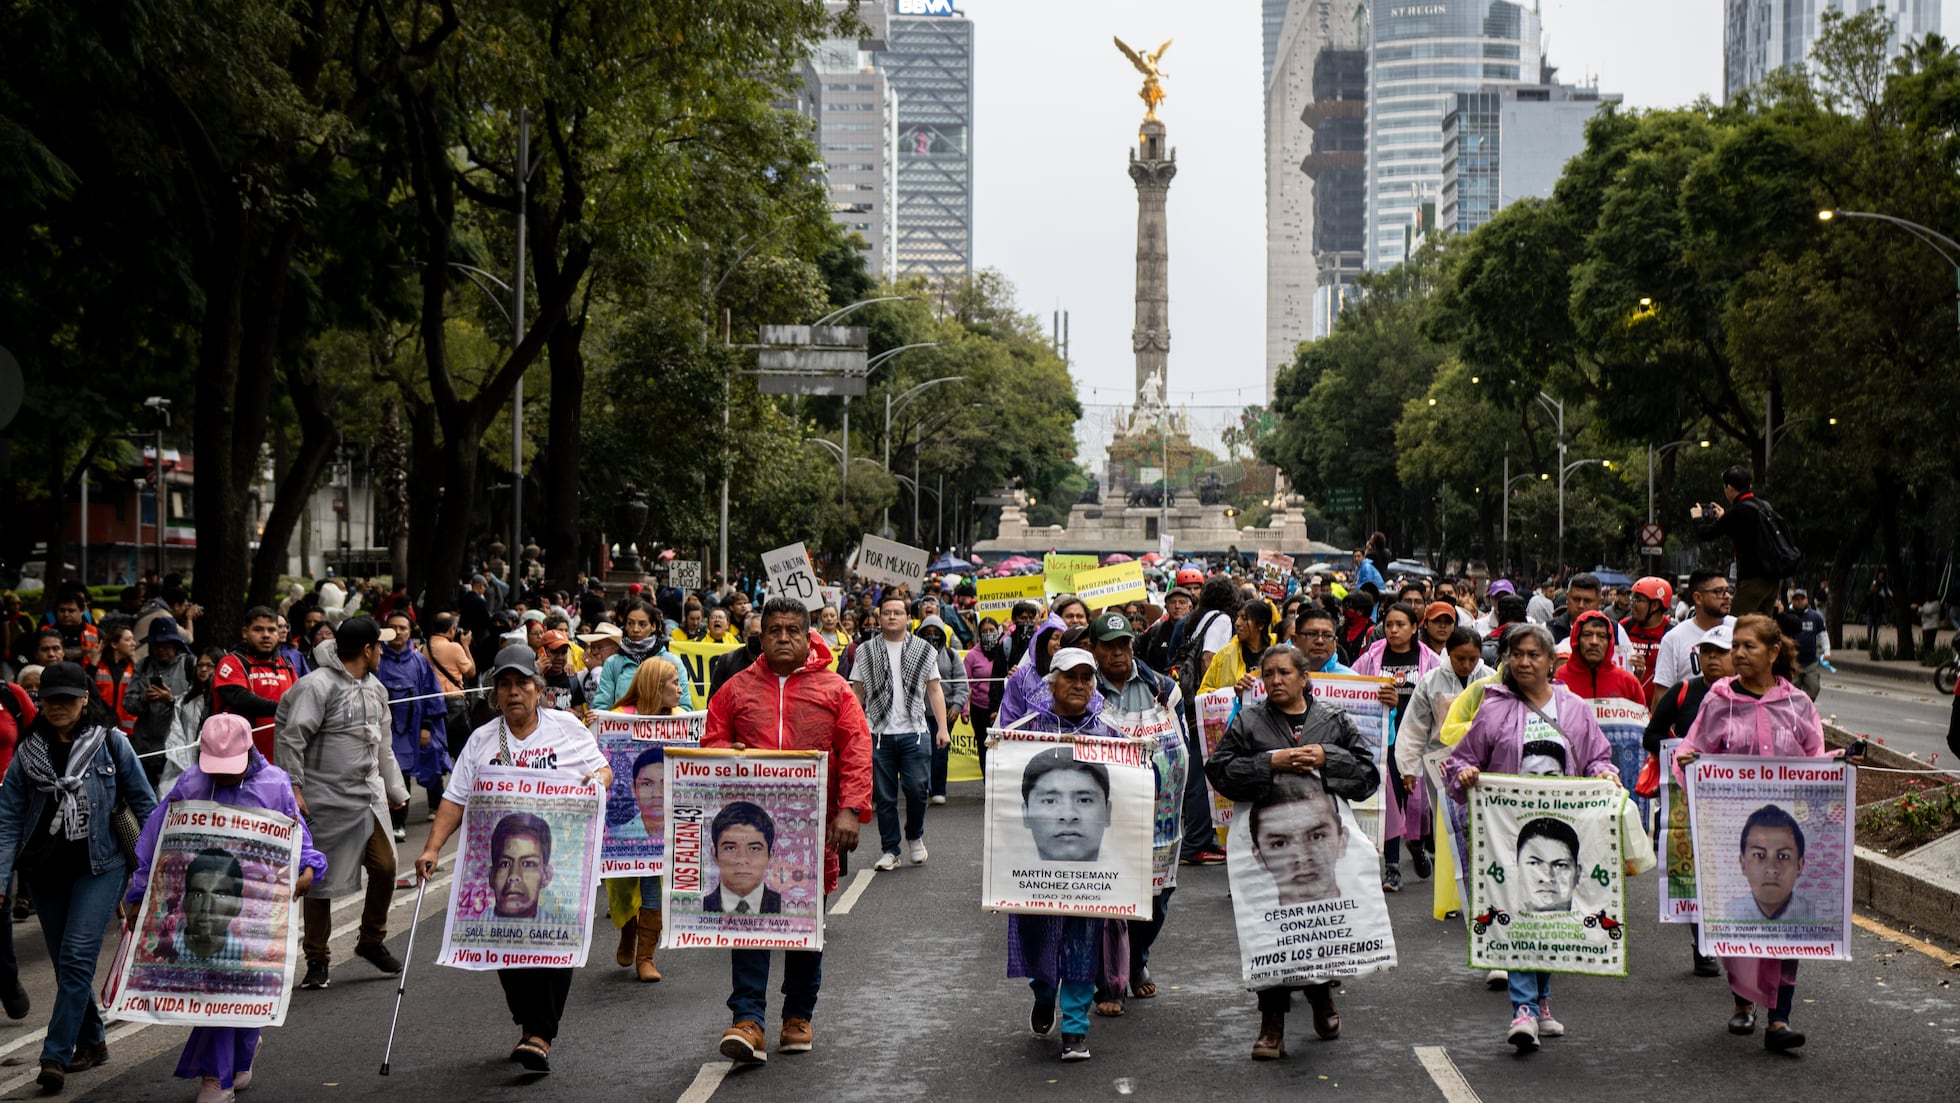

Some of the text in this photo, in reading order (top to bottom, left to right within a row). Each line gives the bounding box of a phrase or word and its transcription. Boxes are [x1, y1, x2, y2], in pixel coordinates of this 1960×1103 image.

[898, 0, 952, 14] BBVA
[1408, 5, 1446, 16] REGIS
[686, 560, 699, 571] LOS
[769, 556, 806, 575] NOS FALTAN
[865, 549, 883, 569] POR
[1047, 558, 1066, 570] Nos
[678, 569, 695, 578] 800
[1077, 577, 1122, 591] #AYOTZINAPA
[1078, 588, 1105, 600] CRIMEN
[1116, 580, 1143, 592] ESTADO
[979, 590, 1024, 601] #AYOTZINAPA
[980, 601, 1007, 611] CRIMEN
[1203, 694, 1229, 708] ¡Vivo
[1325, 685, 1380, 701] llevaron
[600, 720, 629, 734] ¡Vivo
[633, 720, 653, 740] NOS
[655, 718, 688, 740] FALTAN
[1074, 742, 1098, 761] NOS
[1100, 741, 1141, 768] FALTAN
[675, 761, 817, 779] ¡Vivo se lo llevaron!
[1697, 764, 1844, 782] ¡Vivo se lo llevaron!
[497, 781, 514, 791] se
[518, 780, 532, 794] lo
[536, 781, 597, 796] llevaron!
[1485, 794, 1610, 809] ¡Vivo se lo llevaron!
[191, 812, 207, 826] se
[211, 812, 227, 827] lo
[231, 815, 291, 841] llevaron!
[673, 805, 703, 891] NOS FALTAN 43!
[602, 859, 631, 874] ¡Vivo
[634, 859, 645, 870] lo
[1012, 868, 1119, 880] MARTÍN GETSEMANY
[1486, 861, 1505, 884] 43
[1590, 863, 1610, 887] 43
[1018, 880, 1112, 891] SÁNCHEZ GARCÍA
[458, 889, 490, 915] 43
[1075, 893, 1102, 901] AÑOS
[1264, 899, 1359, 922] CÉSAR MANUEL
[1675, 900, 1698, 915] ¡Viv
[698, 916, 790, 927] JORGE ÁLVAREZ NAVA
[1280, 914, 1347, 933] GONZÁLEZ
[1509, 922, 1584, 932] JORGE ANTONIO
[465, 925, 569, 940] SAÚL BRUNO GARCÍA
[676, 932, 808, 948] ¡Vivo lo queremos!
[1277, 927, 1353, 947] HERNÁNDEZ
[1507, 930, 1586, 940] TIZAPA LEGIDEÑO
[1250, 939, 1383, 970] ¡VIVOS LOS QUEREMOS!
[1486, 940, 1608, 955] ¡Con VIDA lo queremos!
[1713, 941, 1835, 957] ¡Vivo lo queremos!
[452, 949, 573, 967] ¡Vivo lo queremos!
[124, 996, 274, 1017] ¡Con VIDA lo queremos!
